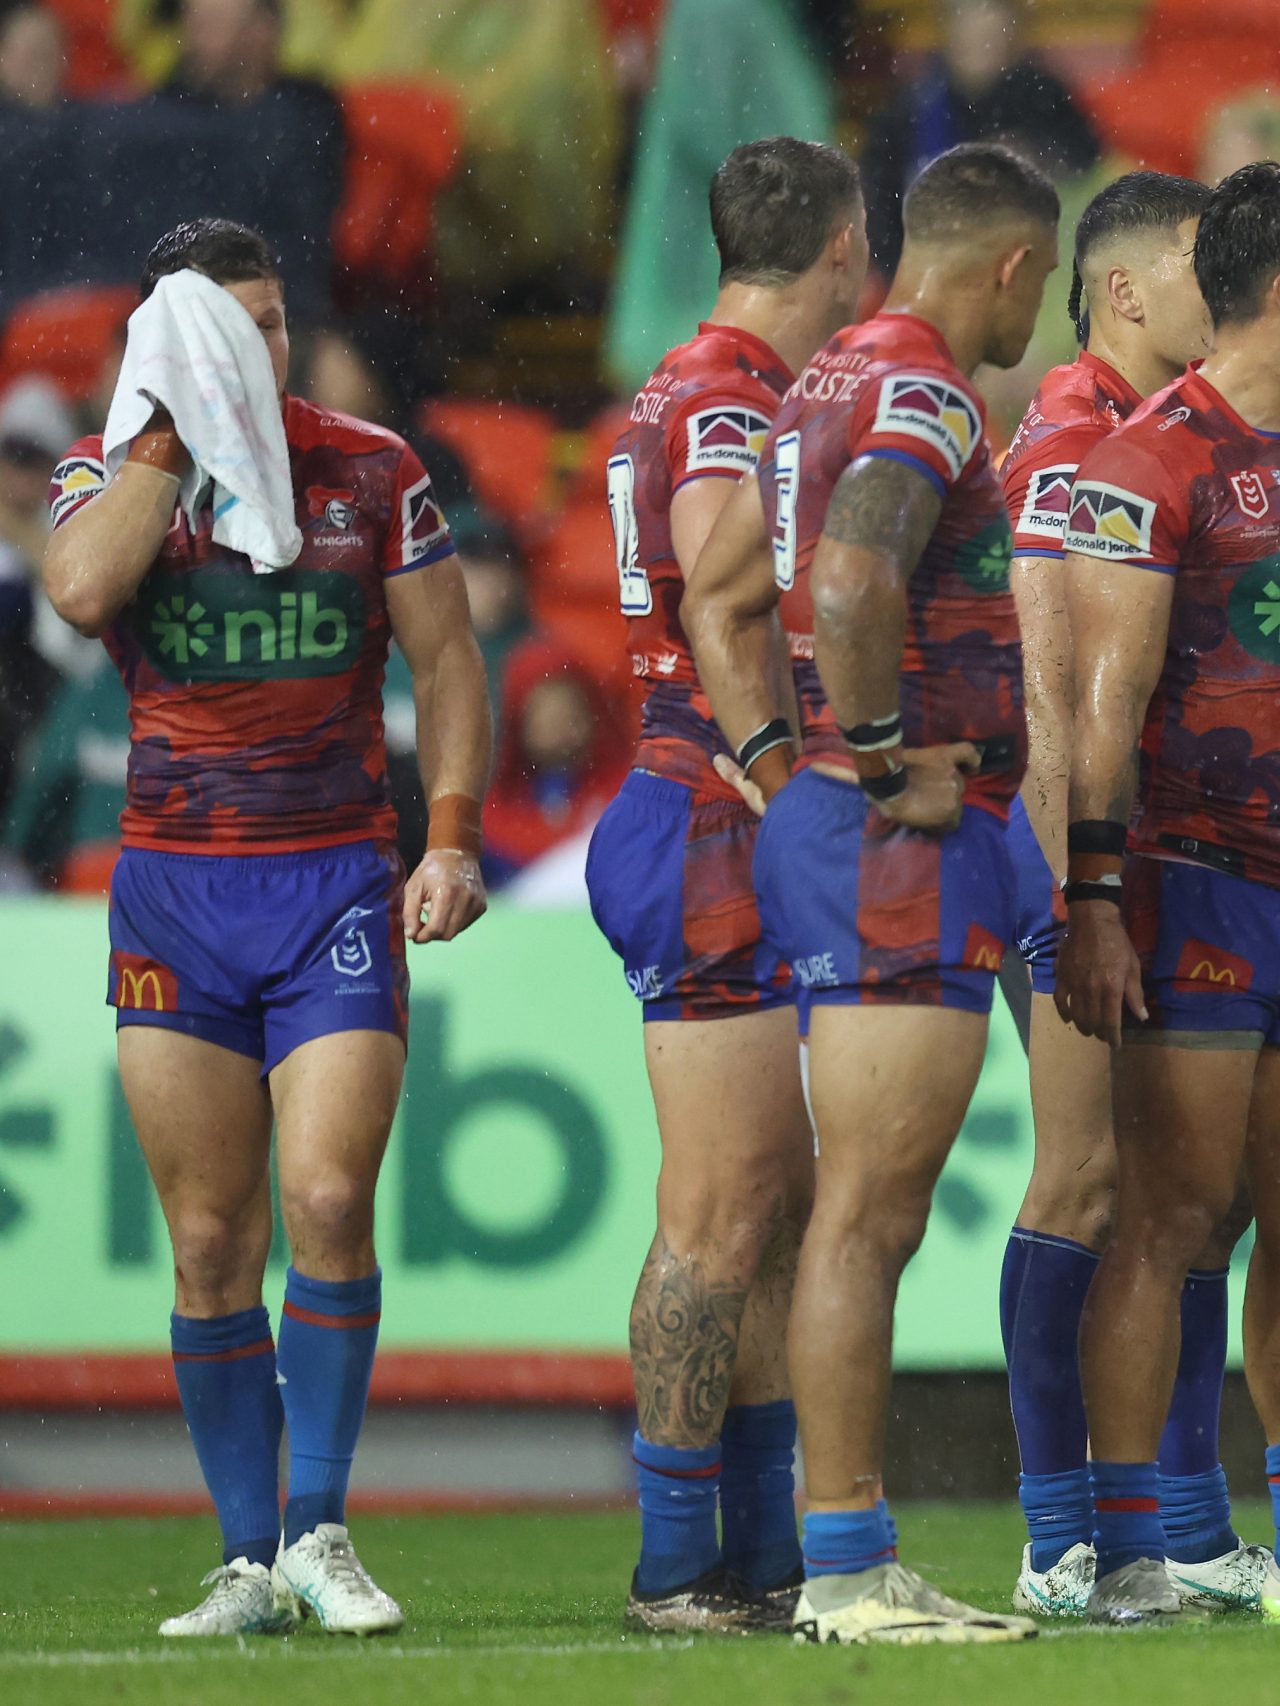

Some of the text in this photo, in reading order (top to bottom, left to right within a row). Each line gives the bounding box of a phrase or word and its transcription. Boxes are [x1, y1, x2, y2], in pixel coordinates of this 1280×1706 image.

[1029, 514, 1068, 529] mcdon
[313, 535, 363, 547] KNIGHTS
[1108, 540, 1142, 554] jones
[224, 591, 348, 663] nib
